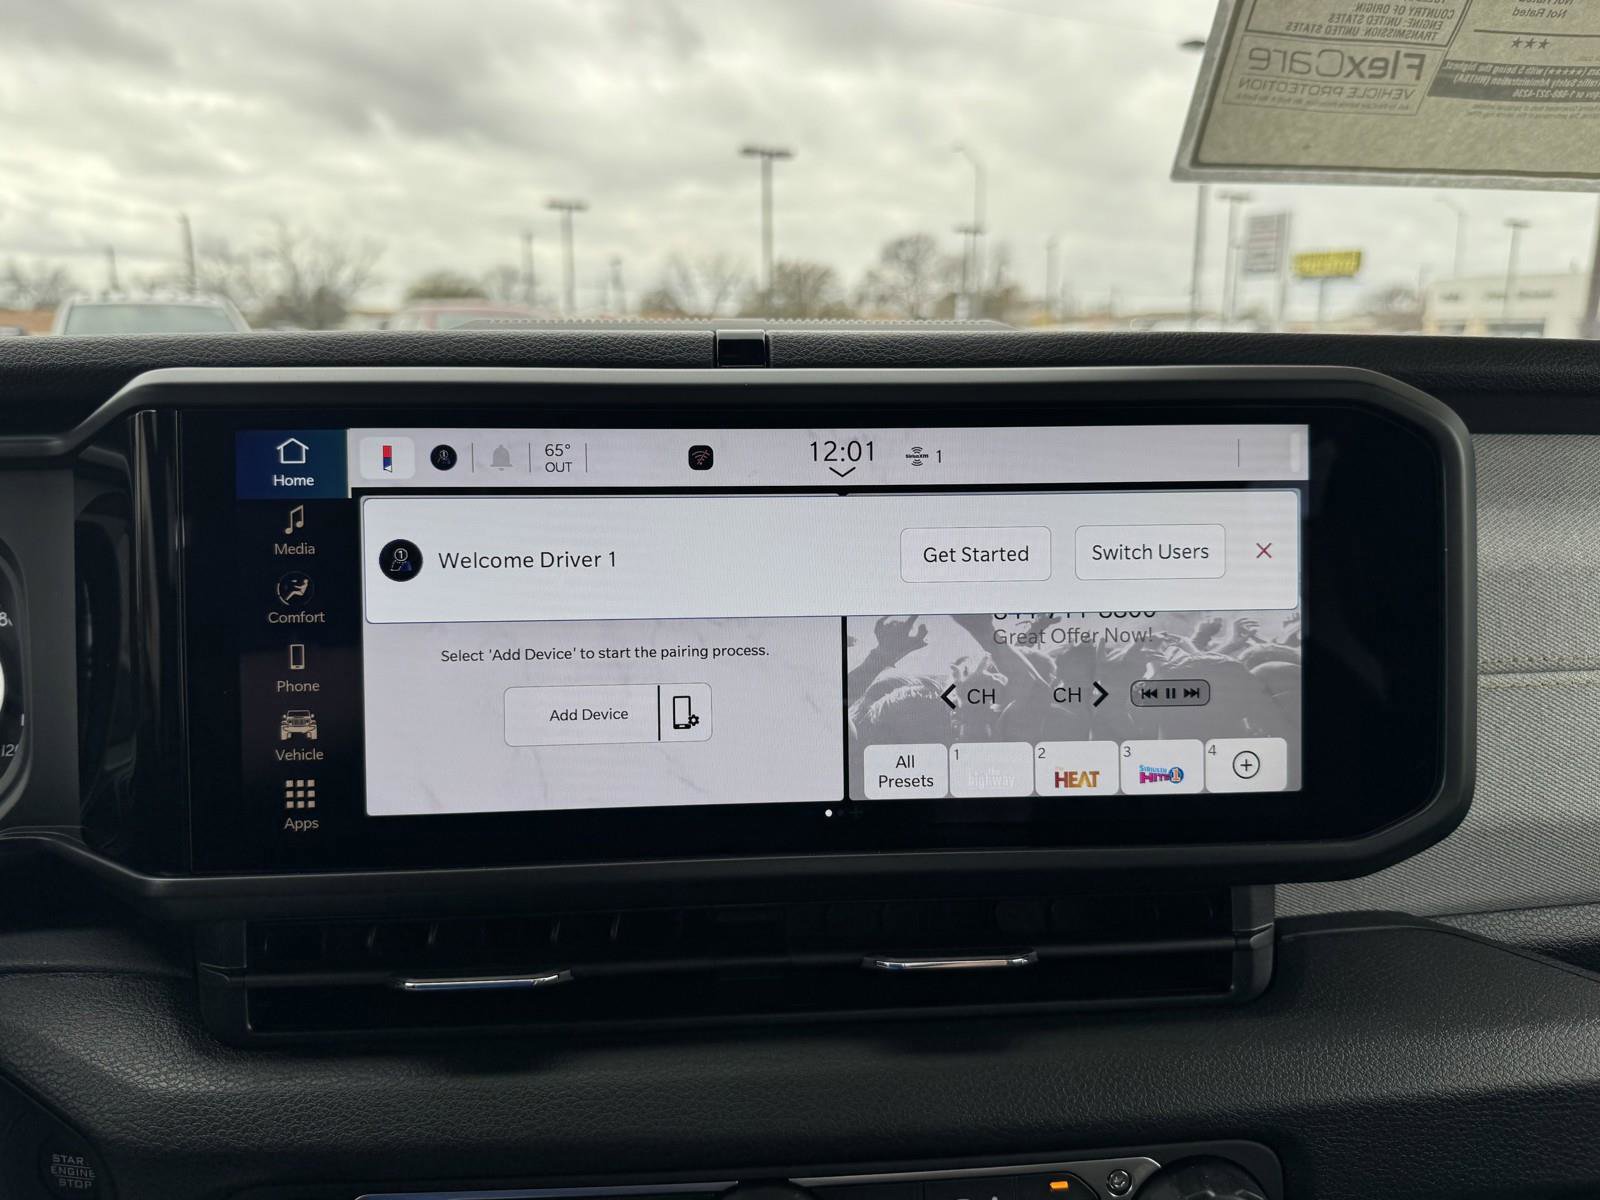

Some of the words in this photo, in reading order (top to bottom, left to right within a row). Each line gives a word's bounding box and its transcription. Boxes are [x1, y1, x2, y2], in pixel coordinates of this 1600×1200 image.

[545, 444, 570, 456] 65°
[810, 440, 876, 462] 12:01
[936, 449, 942, 464] 1
[545, 462, 572, 472] OUT
[274, 475, 314, 486] Home
[275, 543, 315, 554] Media
[924, 547, 956, 562] Get
[962, 546, 1028, 562] Started
[1093, 544, 1153, 561] Switch
[1159, 544, 1208, 559] Users
[439, 552, 533, 568] Welcome
[541, 552, 601, 567] Driver
[608, 551, 615, 568] 1
[269, 611, 325, 623] Comfort
[992, 629, 1046, 645] Great
[1051, 628, 1100, 644] Offer
[1104, 626, 1153, 642] Now!
[441, 650, 484, 661] Select
[490, 649, 520, 660] 'Add
[526, 648, 575, 660] Device'
[580, 649, 594, 659] to
[599, 648, 630, 658] start
[635, 647, 656, 657] the
[661, 645, 708, 660] pairing
[713, 647, 769, 659] process.
[278, 680, 319, 692] Phone
[967, 689, 996, 705] CH
[1053, 687, 1082, 704] CH
[550, 709, 577, 721] Add
[583, 708, 628, 720] Device
[276, 748, 323, 760] Vehicle
[954, 749, 959, 760] 1
[1039, 748, 1045, 758] 2
[1124, 746, 1131, 757] 3
[1208, 744, 1217, 756] 4
[896, 755, 914, 768] All
[879, 775, 933, 788] Presets
[1055, 771, 1100, 788] HEAT
[284, 818, 320, 831] Apps
[51, 1166, 96, 1178] ENGINE
[59, 1178, 92, 1189] STOP
